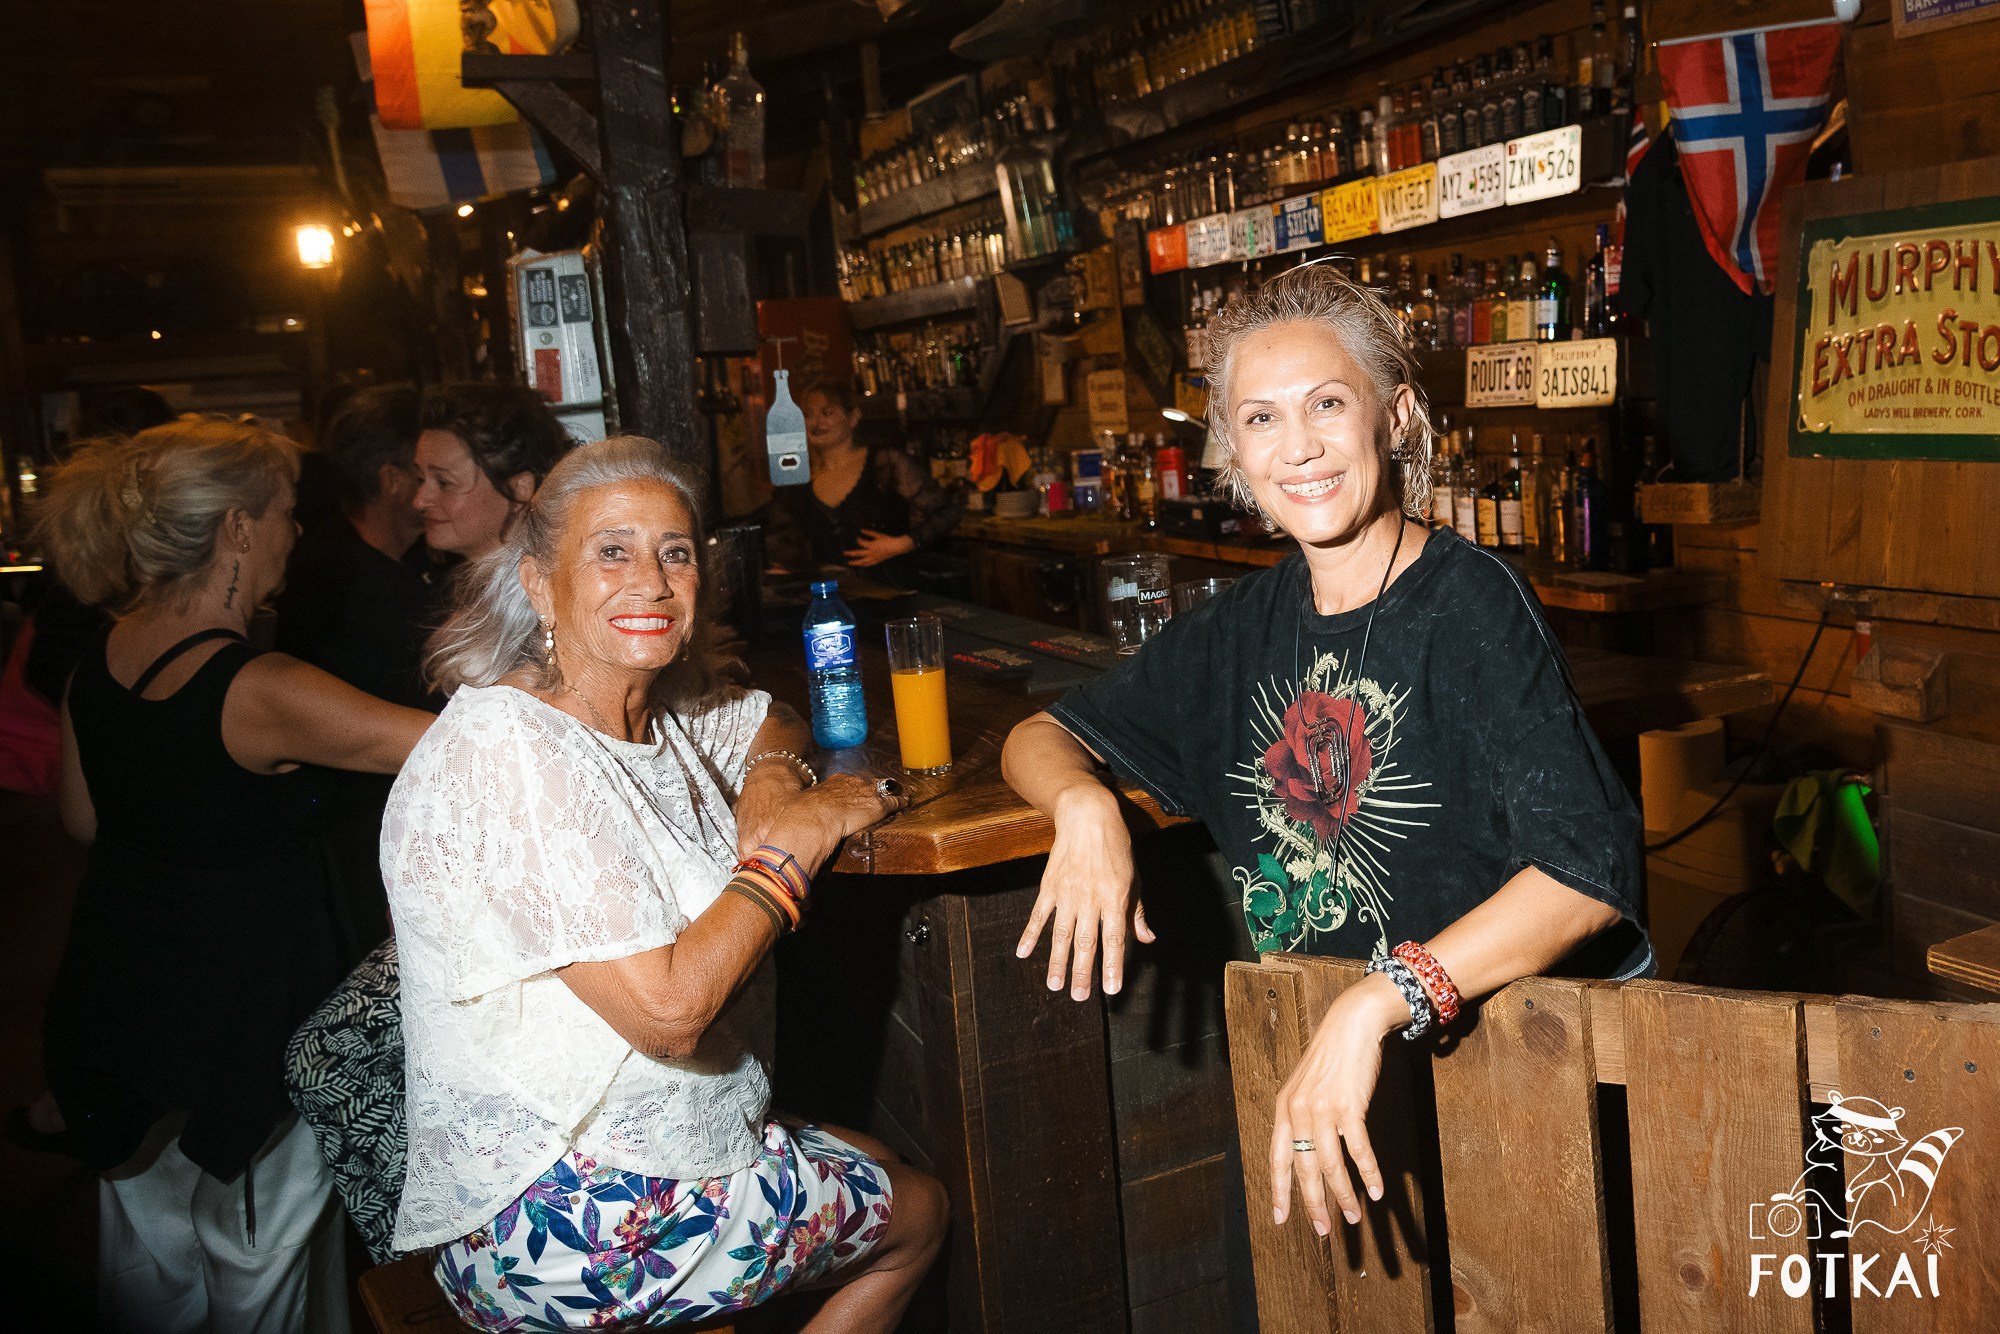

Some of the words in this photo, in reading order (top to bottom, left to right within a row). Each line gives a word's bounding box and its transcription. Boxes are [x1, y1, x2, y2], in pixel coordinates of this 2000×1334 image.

[1508, 156, 1536, 189] ZXN
[1547, 148, 1575, 181] 526
[1441, 172, 1463, 201] AYZ
[1471, 358, 1511, 392] ROUTE
[1515, 356, 1533, 390] 66
[1812, 318, 1921, 398] EXTRA
[1541, 365, 1610, 397] 3AIS841
[1848, 390, 1865, 408] ON
[1867, 378, 1920, 400] DRAUGHT
[1925, 378, 1934, 393] &
[1937, 378, 1950, 396] IN
[1864, 406, 1890, 419] LADY'S
[1892, 407, 1911, 418] WELL
